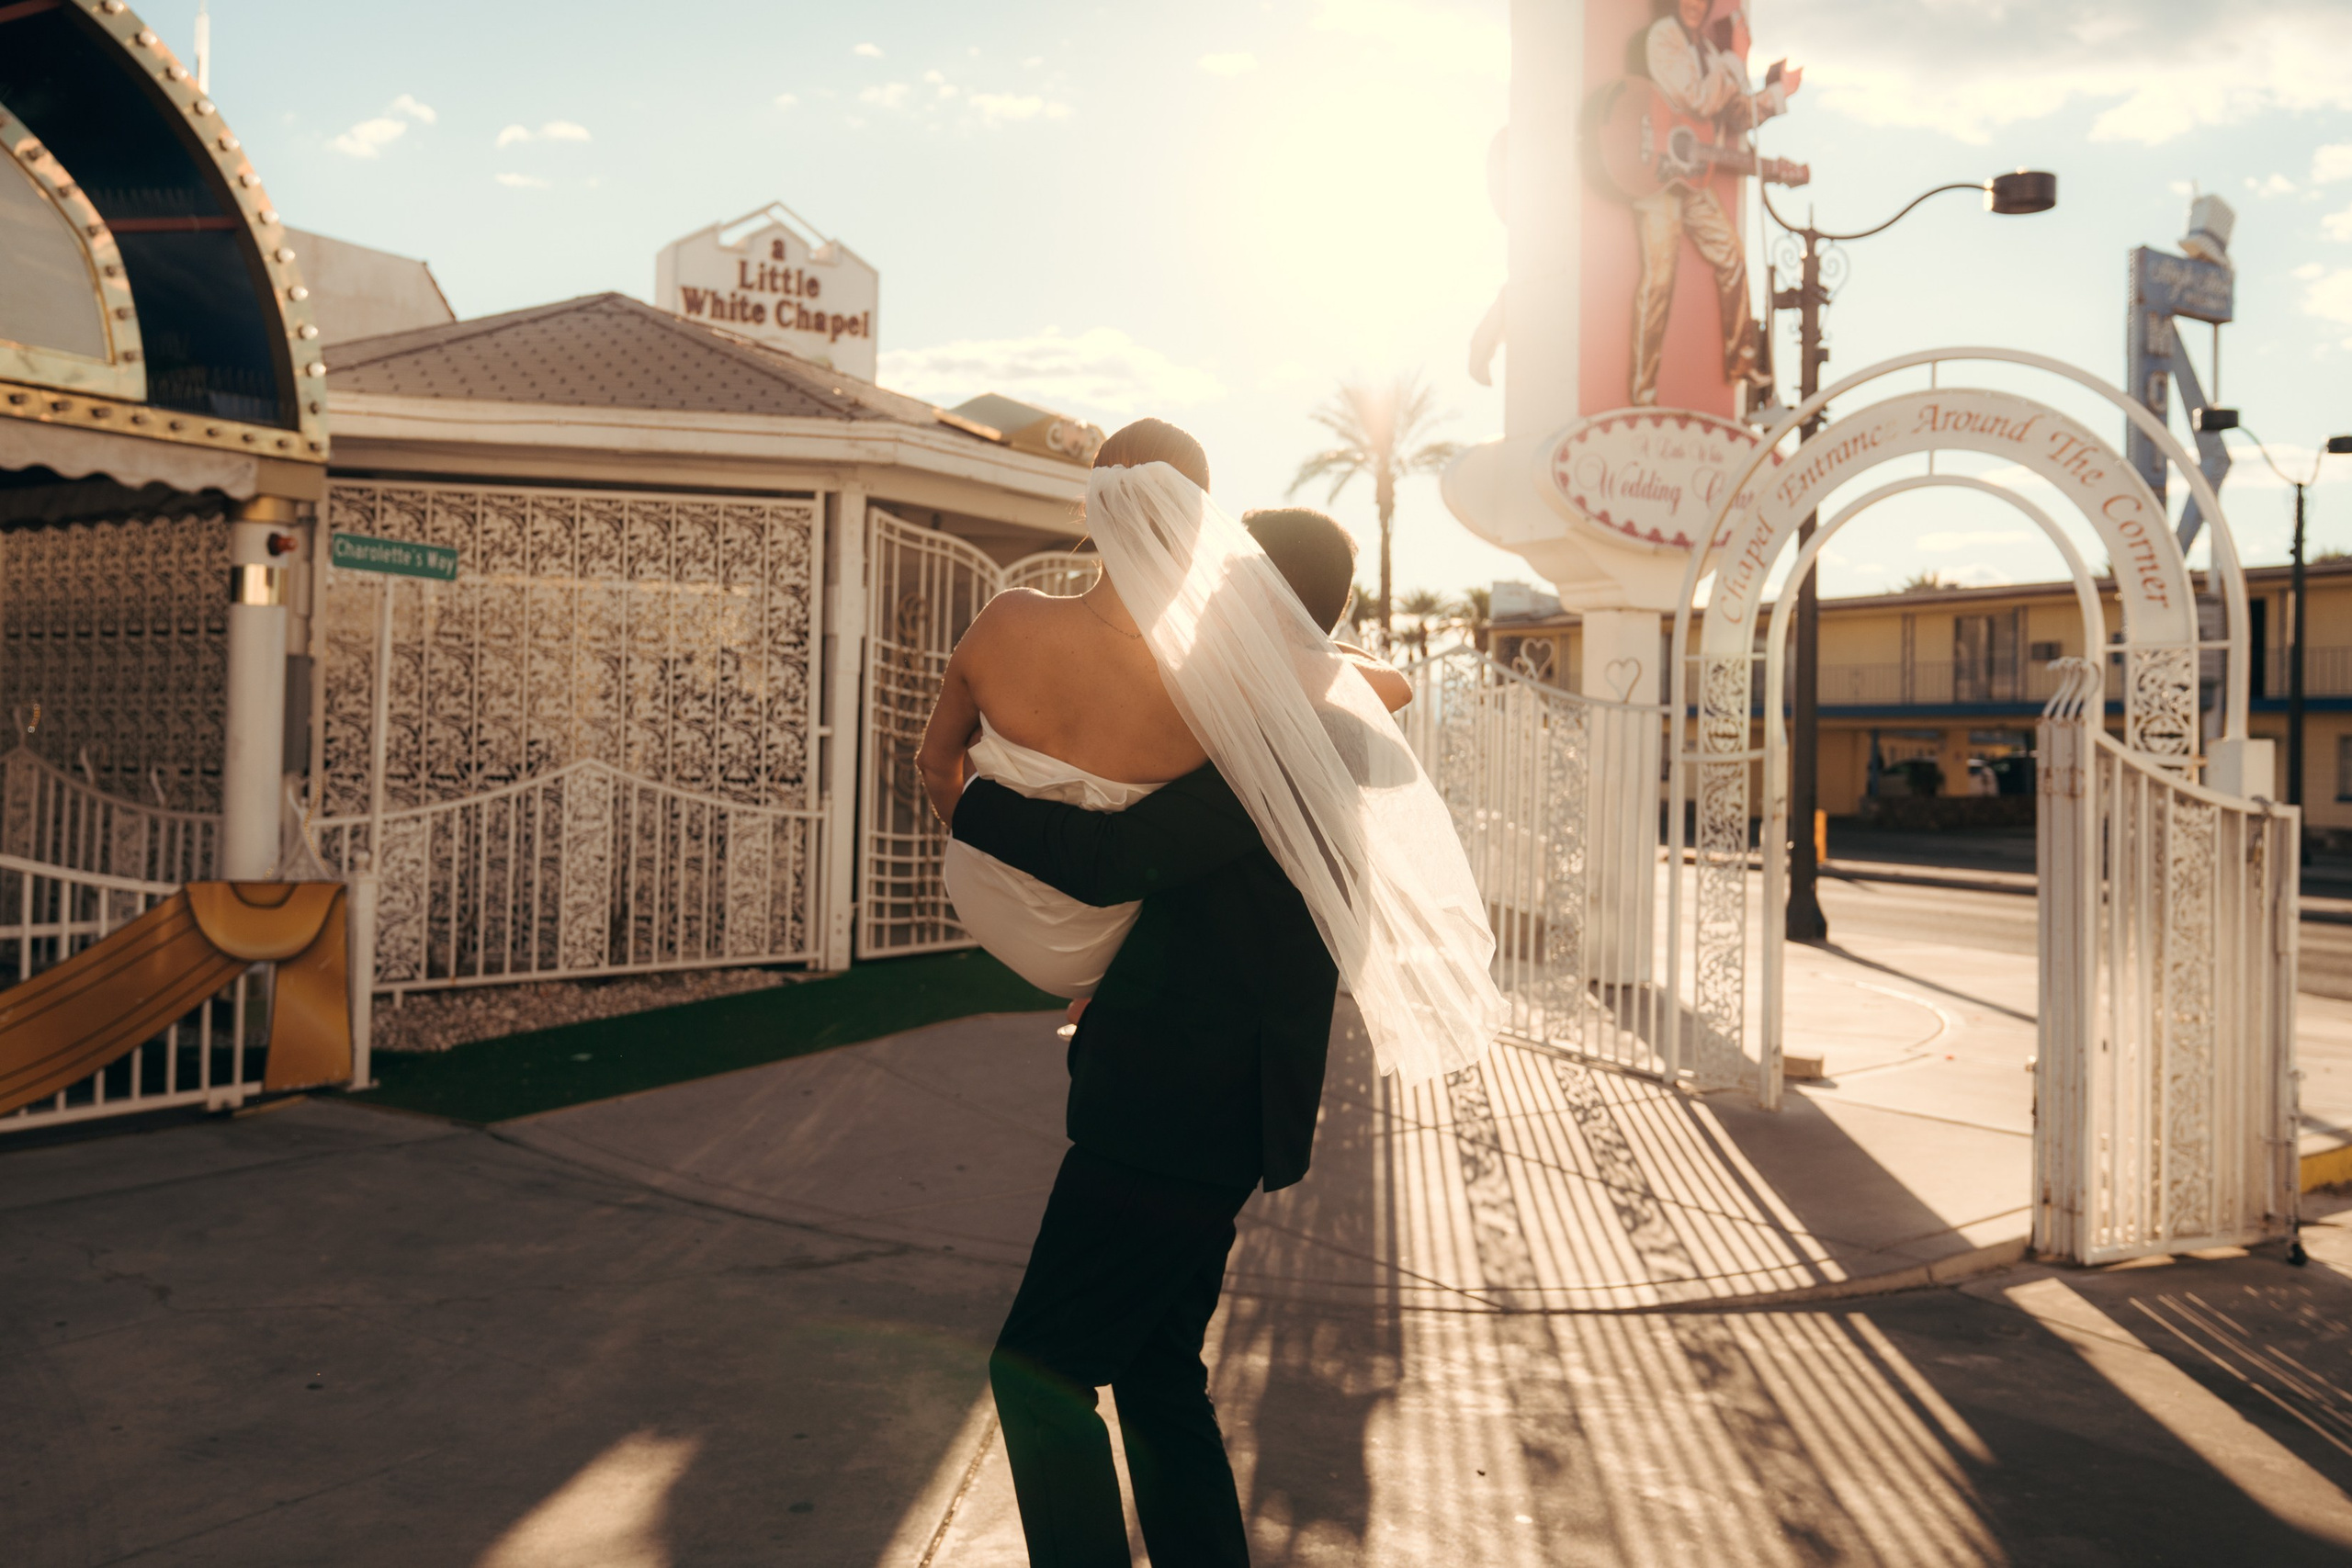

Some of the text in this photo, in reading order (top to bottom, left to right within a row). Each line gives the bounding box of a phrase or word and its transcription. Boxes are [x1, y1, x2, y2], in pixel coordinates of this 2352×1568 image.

[772, 239, 786, 261] a
[738, 260, 820, 299] Little
[680, 284, 870, 343] White Chapel
[1574, 453, 1682, 516] Wedding
[1720, 506, 1774, 624] Chapel
[1911, 403, 2045, 443] Around
[2048, 431, 2104, 488] The
[2101, 493, 2169, 608] Corner
[427, 549, 456, 577] Way
